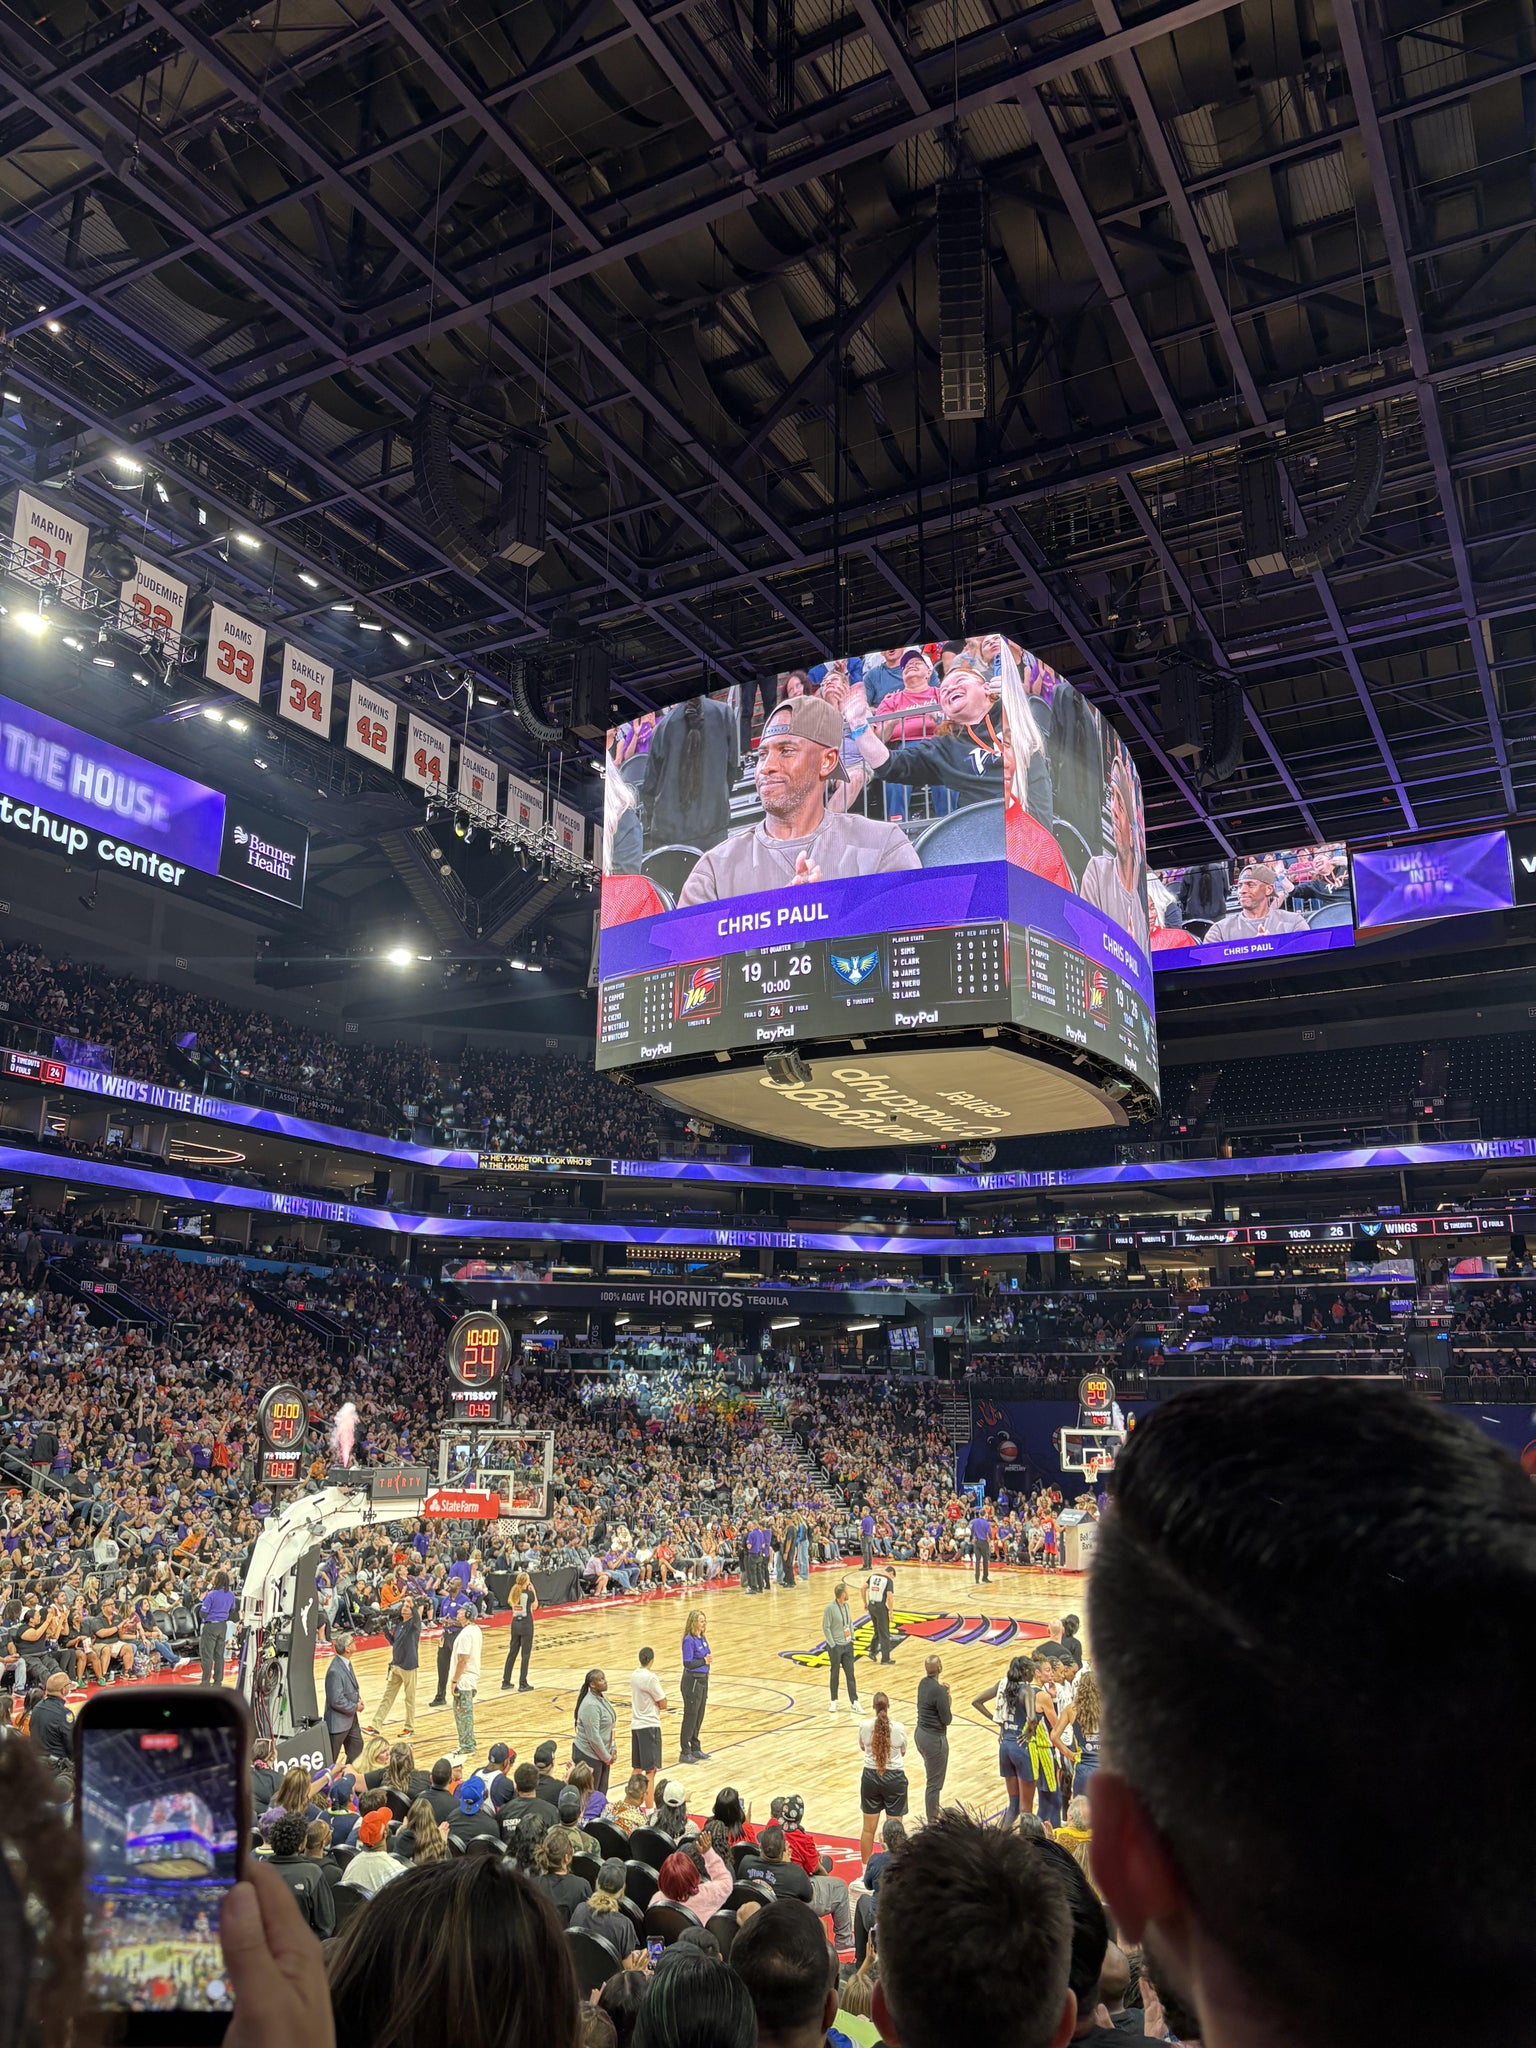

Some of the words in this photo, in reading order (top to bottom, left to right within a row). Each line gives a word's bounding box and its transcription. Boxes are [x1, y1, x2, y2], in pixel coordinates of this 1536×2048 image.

[31, 512, 73, 546] MARION
[135, 572, 184, 608] OUDEMIRE
[223, 622, 252, 646] ADAMS
[217, 640, 254, 685] 33
[291, 658, 325, 686] BARKLEY
[289, 679, 322, 722] 34
[357, 694, 389, 720] HAWKINS
[356, 715, 388, 754] 42
[412, 726, 446, 754] WESTPHAL
[3, 723, 70, 790] THE
[414, 748, 441, 781] 44
[249, 833, 296, 866] Banner
[98, 839, 186, 886] center
[1409, 869, 1424, 882] IN
[1424, 865, 1449, 881] THE
[717, 911, 771, 936] CHRIS
[777, 902, 829, 926] PAUL
[1102, 932, 1125, 963] CHRIS
[1223, 945, 1249, 956] CHRIS
[1251, 943, 1274, 952] PAUL
[789, 955, 812, 976] 26
[900, 957, 920, 966] CLARK
[742, 963, 762, 983] 19
[900, 968, 920, 977] JAMES
[761, 979, 791, 994] 10:00
[900, 990, 920, 999] LAKSA
[1115, 987, 1124, 1008] 19
[770, 1006, 780, 1017] 24
[895, 1010, 938, 1027] PayPal
[756, 1024, 795, 1042] PayPal
[1065, 1024, 1087, 1044] PayPal
[11, 1055, 16, 1063] 5
[640, 1042, 672, 1059] PayPal
[50, 1067, 60, 1078] 24
[102, 1074, 149, 1103] WHO'S
[151, 1086, 165, 1107] IN
[167, 1089, 193, 1113] THE
[832, 1068, 968, 1132] matchup
[759, 1076, 941, 1142] mortgage
[936, 1090, 1011, 1118] center
[1471, 1140, 1525, 1158] WHO'S
[504, 1163, 530, 1171] HOUSE
[546, 1157, 565, 1165] LOOK
[566, 1158, 583, 1166] WHO
[977, 1174, 1016, 1189] WHO'S
[1033, 1171, 1055, 1186] THE
[271, 1194, 308, 1217] WHO'S
[312, 1200, 322, 1218] IN
[324, 1202, 344, 1221] THE
[1330, 1226, 1343, 1237] 26
[1385, 1223, 1418, 1234] WINGS
[1443, 1221, 1449, 1230] 5
[1482, 1219, 1488, 1228] 0
[716, 1230, 756, 1246] WHO'S
[760, 1231, 771, 1247] IN
[773, 1233, 796, 1248] THE
[1255, 1230, 1267, 1240] 19
[1288, 1229, 1310, 1239] 10:00
[206, 1255, 219, 1264] Bell
[600, 1292, 621, 1302] 100%
[621, 1292, 645, 1302] AGAVE
[650, 1289, 744, 1308] HORNITOS
[747, 1296, 789, 1306] TEQUILA
[467, 1329, 499, 1346] 10:00
[463, 1347, 496, 1378] 24
[1088, 1381, 1107, 1391] 10:00
[464, 1391, 498, 1401] TISSOT
[1087, 1390, 1106, 1406] 24
[273, 1403, 299, 1419] 10:00
[272, 1420, 294, 1440] 24
[275, 1451, 301, 1460] TISSOT
